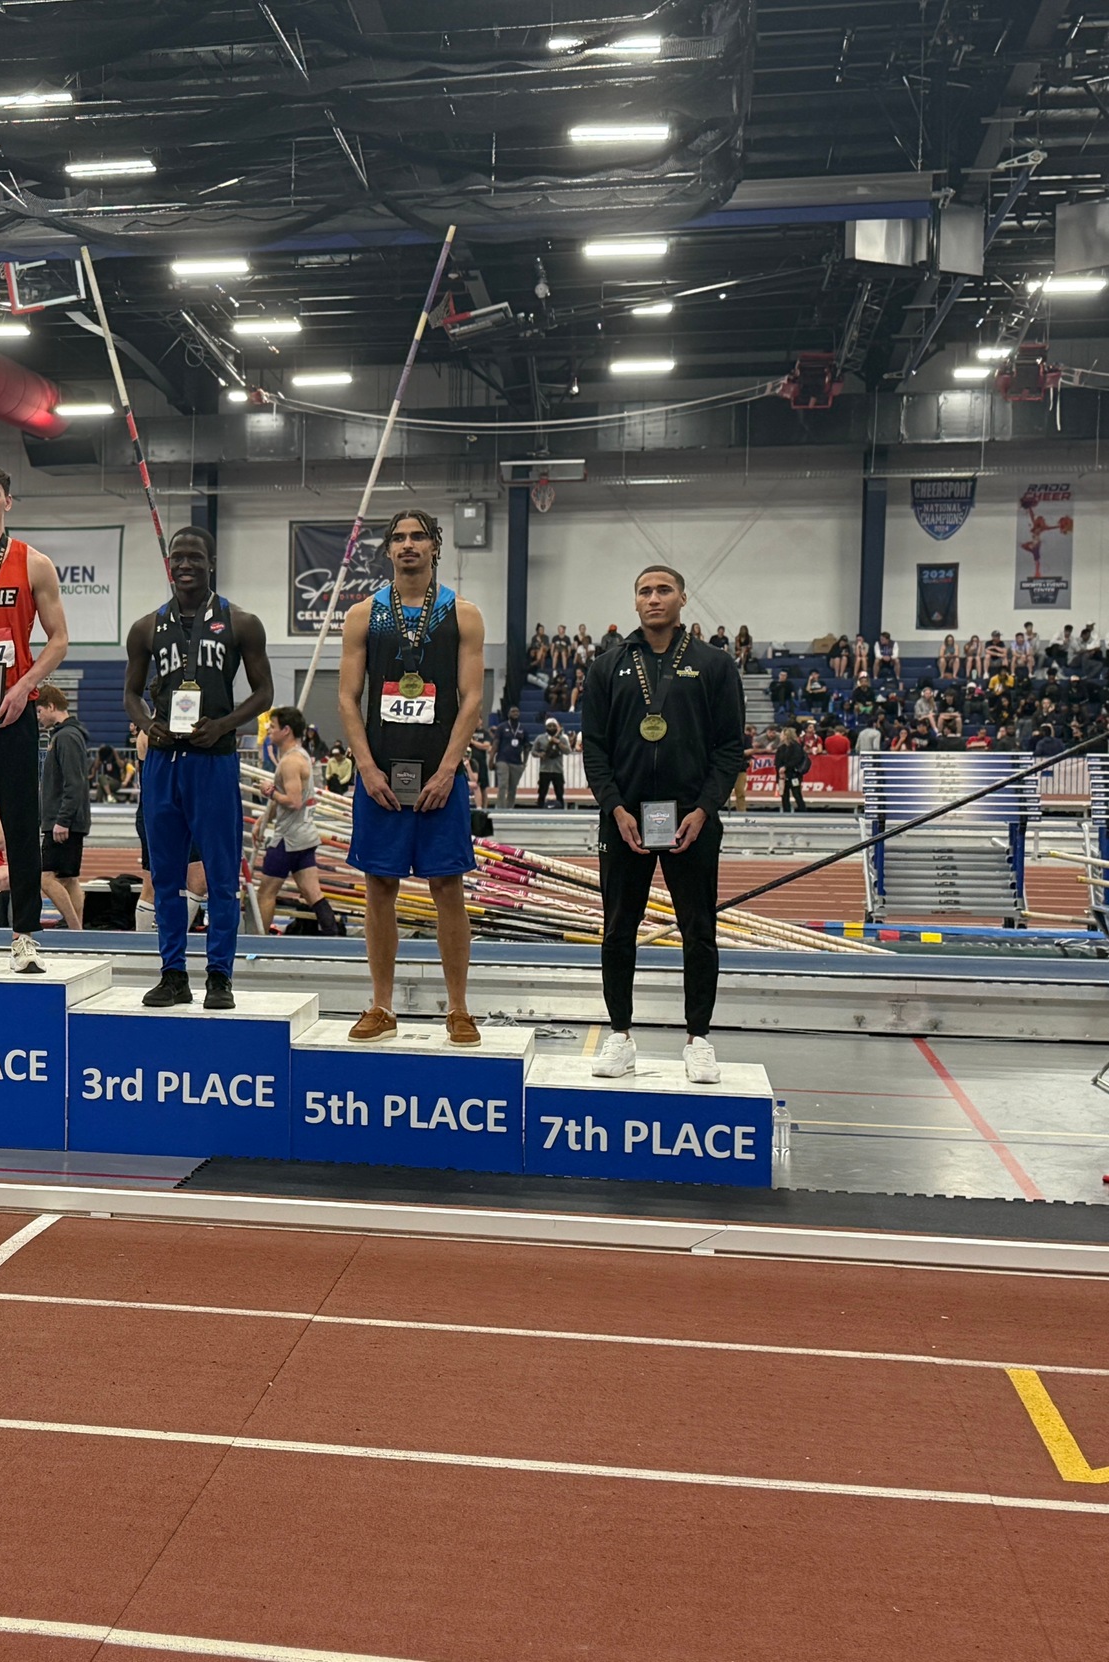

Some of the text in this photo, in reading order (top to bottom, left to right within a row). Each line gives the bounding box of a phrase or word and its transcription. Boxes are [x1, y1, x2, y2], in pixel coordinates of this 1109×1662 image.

[913, 481, 973, 499] CHEERSPORT
[923, 503, 962, 513] NATIONAL
[920, 513, 964, 526] CHAMPIONS
[389, 700, 427, 717] 467
[82, 1067, 275, 1107] 3rd PLACE
[305, 1091, 507, 1133] 5th PLACE
[540, 1115, 756, 1160] 7th PLACE
